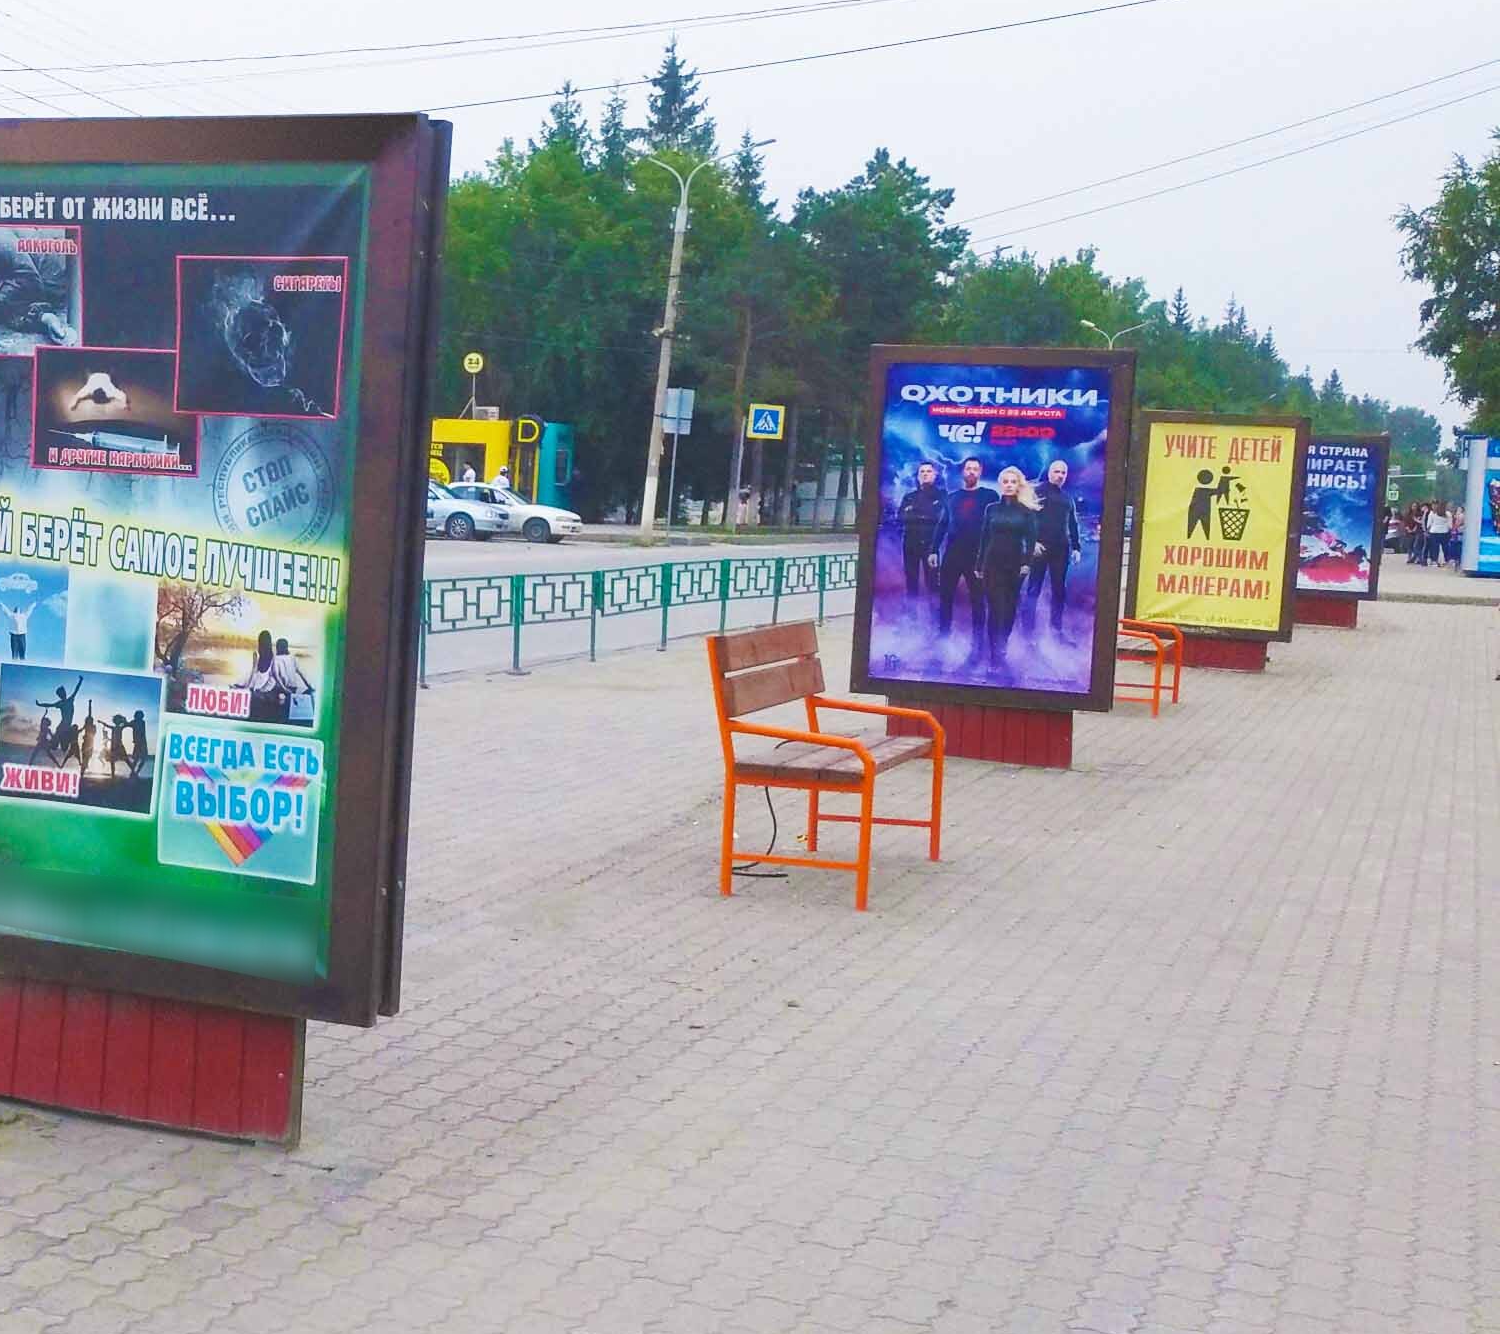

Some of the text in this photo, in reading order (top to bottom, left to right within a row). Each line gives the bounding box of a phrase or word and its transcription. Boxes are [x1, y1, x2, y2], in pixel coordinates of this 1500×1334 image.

[0, 192, 55, 220] БЕРЁТ
[62, 197, 85, 219] ОТ
[92, 197, 165, 220] ЖИЗНИ
[170, 193, 236, 221] ВСЁ...
[17, 239, 78, 255] АЛКОГОЛЬ
[273, 274, 342, 293] СИГАРЕТЫ
[900, 385, 1099, 407] ОХОТНИКИ
[48, 448, 57, 463] И
[60, 449, 107, 465] ДРУГИЕ
[1164, 434, 1283, 464] УЧИТЕ ДЕТЕЙ
[1319, 446, 1368, 457] СТРАНА
[242, 455, 292, 493] СТОП
[1307, 458, 1367, 472] ИРАЕТ
[246, 482, 310, 527] СПАЙС
[20, 507, 103, 566] БЕРЁТ
[108, 524, 198, 581] САМОЕ
[203, 538, 340, 604] ЛУЧШЕЕ!!!
[1164, 545, 1269, 571] ХОРОШИМ
[1156, 573, 1270, 600] МАНЕРАМ!
[186, 685, 249, 717] ЛЮБИ!
[169, 733, 321, 776] ВСЕГДА ЕСТЬ
[2, 766, 79, 795] ЖИВИ!
[175, 781, 303, 828] ВЫБОР!
